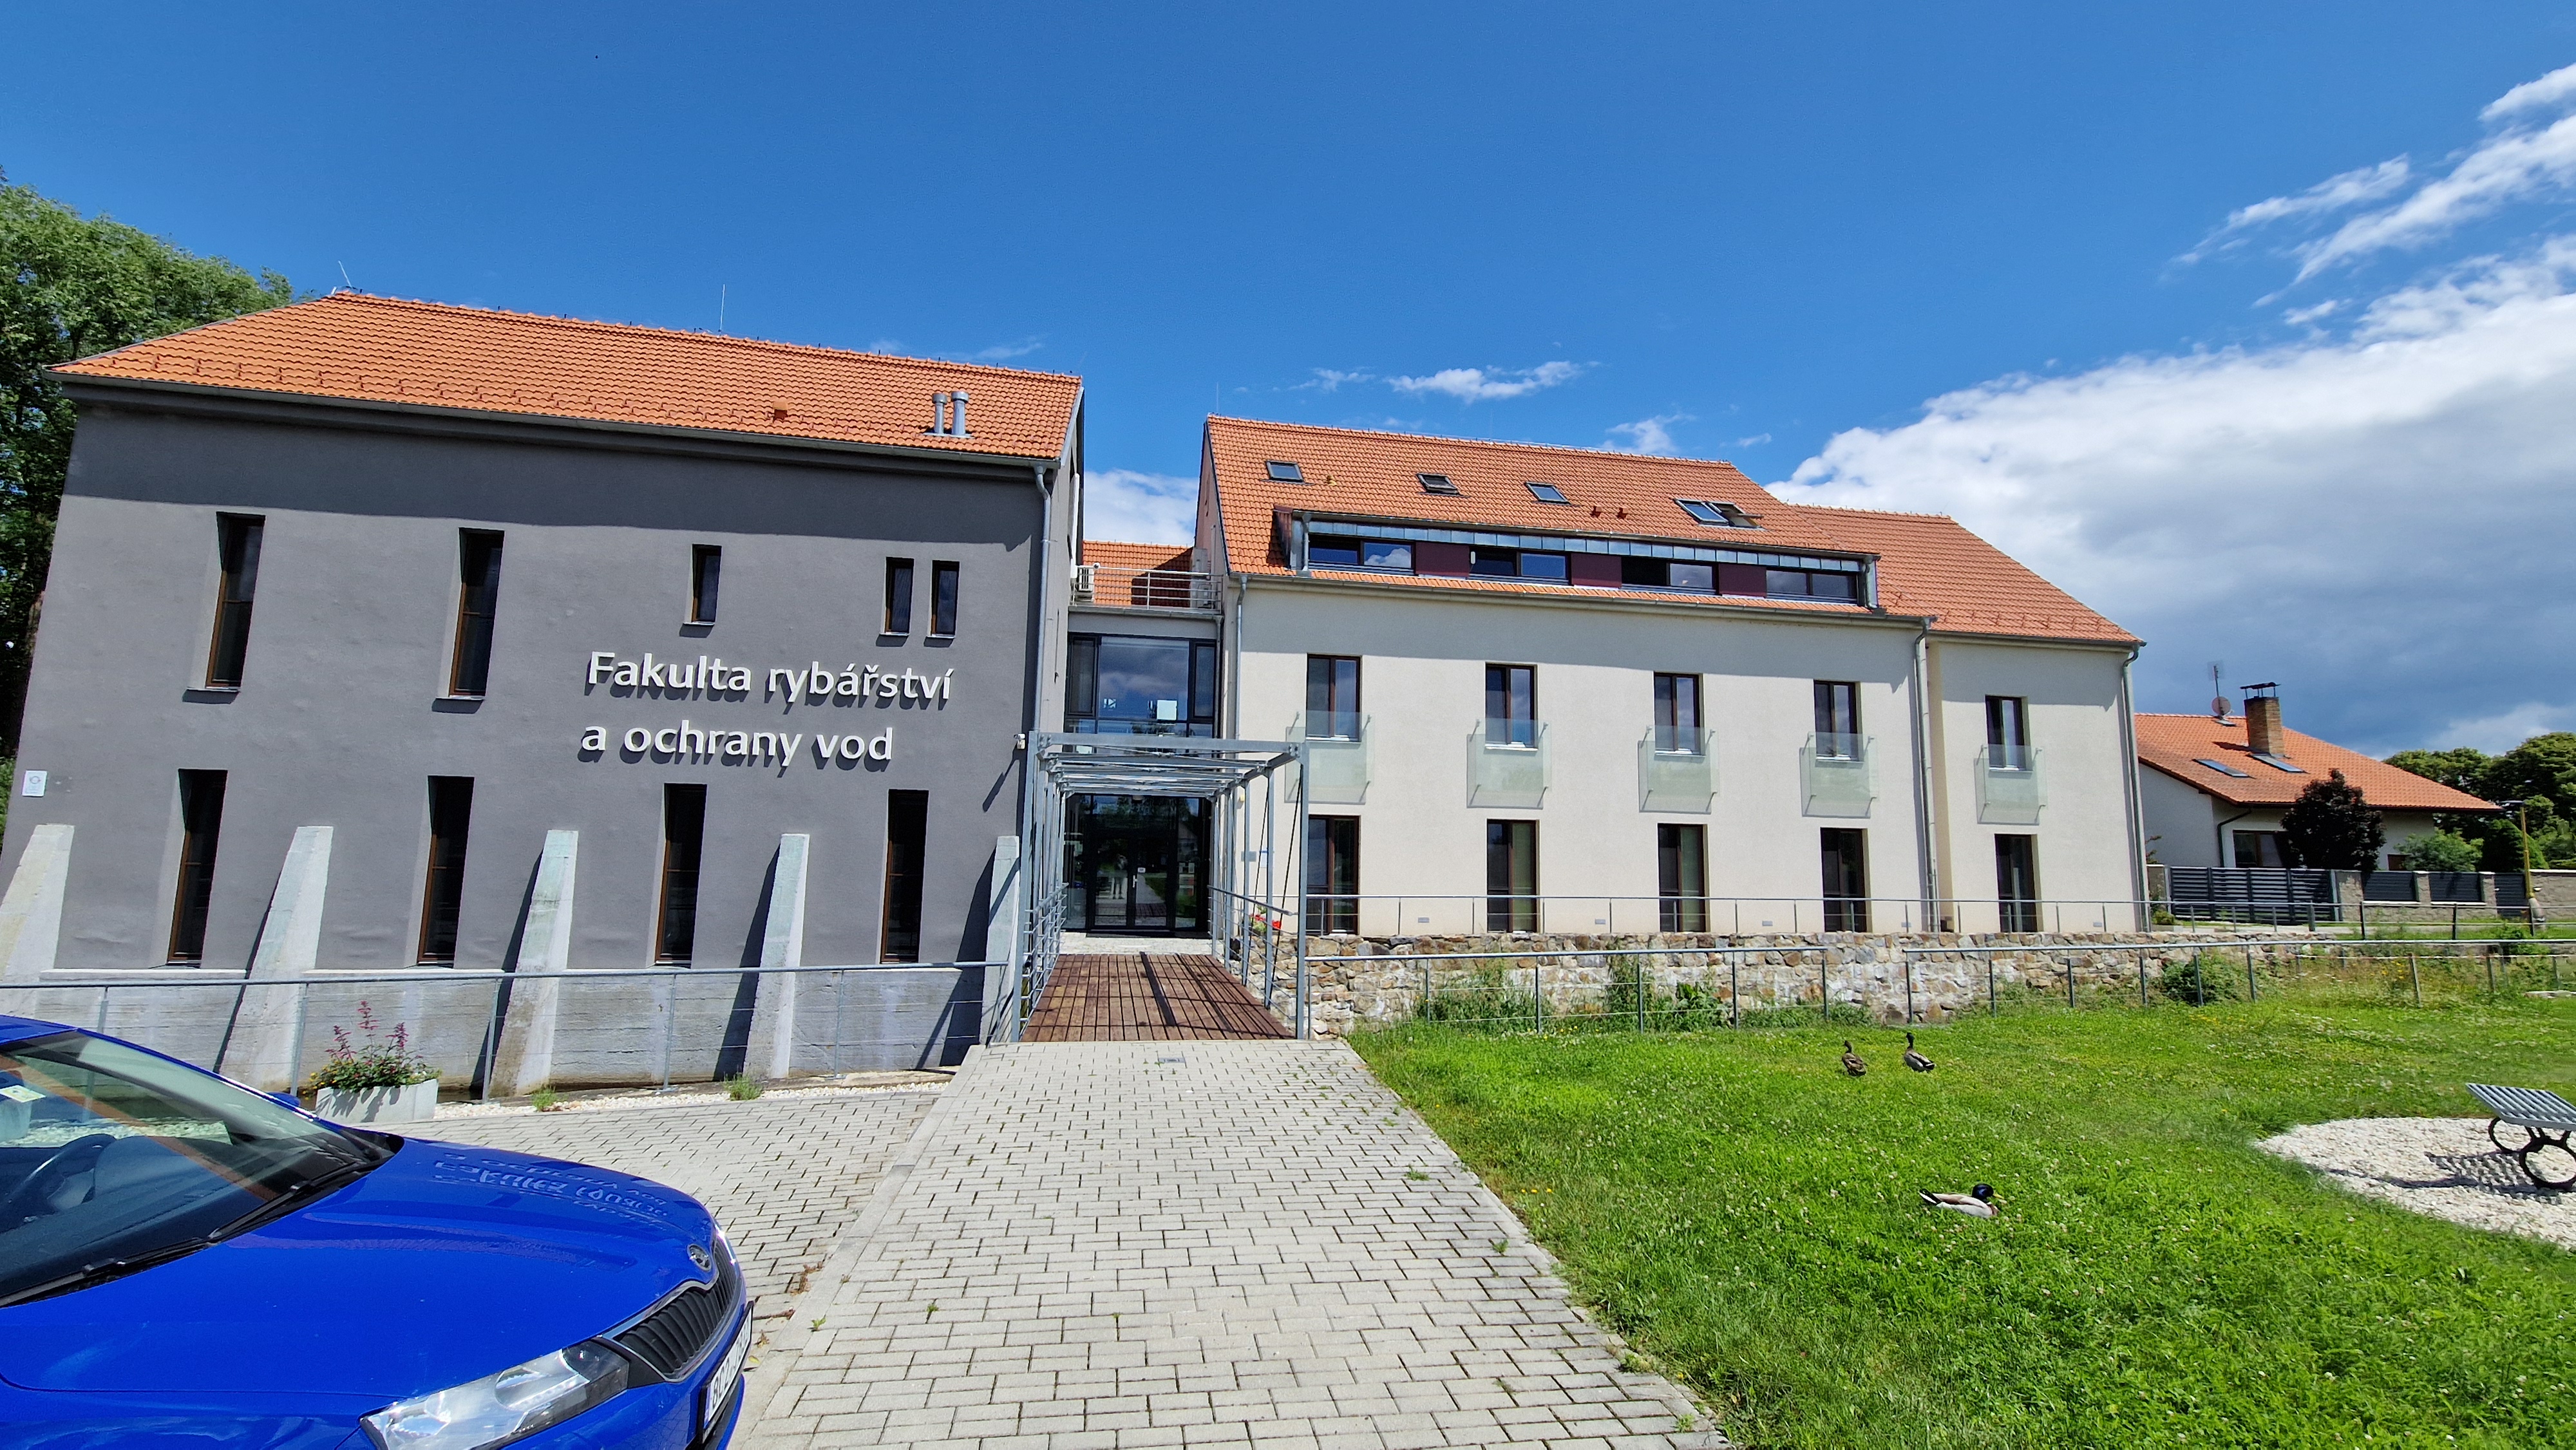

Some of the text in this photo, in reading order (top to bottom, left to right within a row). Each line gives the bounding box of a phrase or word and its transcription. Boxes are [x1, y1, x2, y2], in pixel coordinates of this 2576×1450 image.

[589, 651, 954, 702] Fakulta rybářství
[582, 719, 893, 766] a ochrany vod
